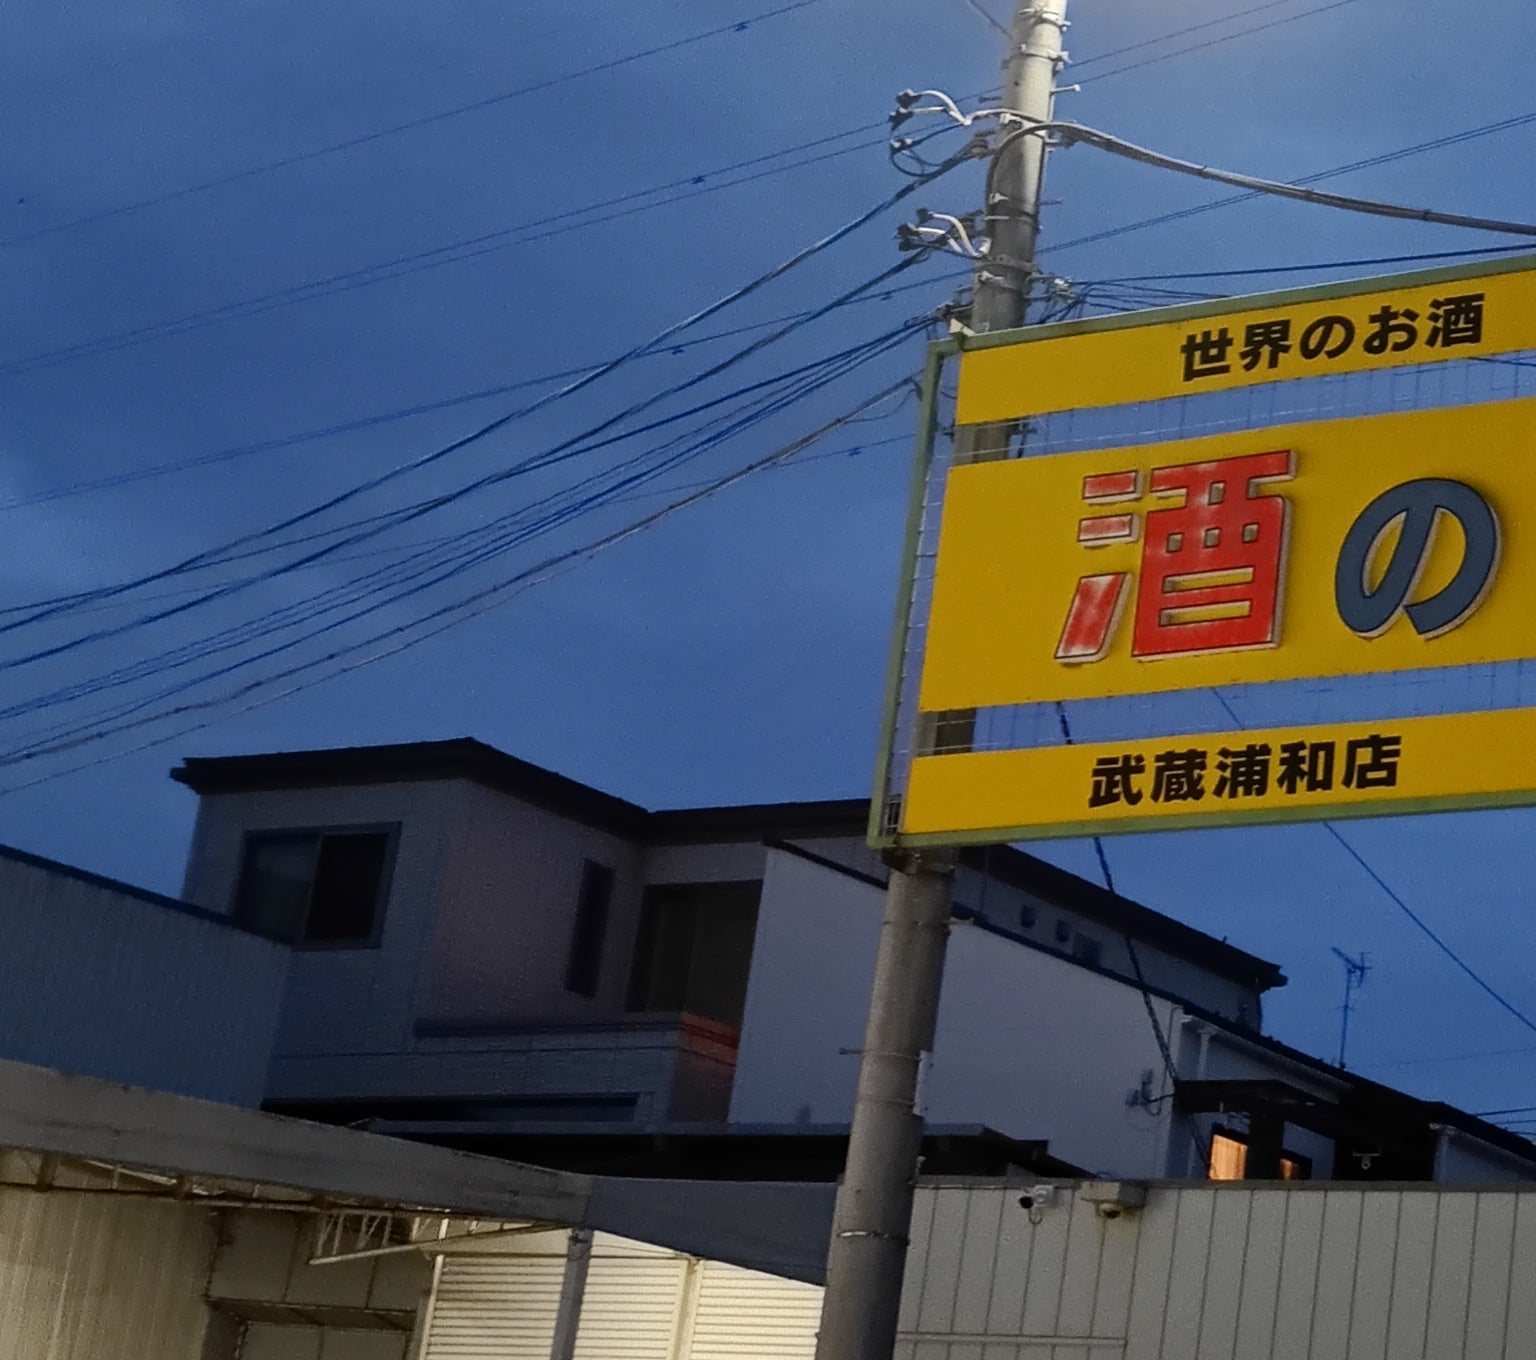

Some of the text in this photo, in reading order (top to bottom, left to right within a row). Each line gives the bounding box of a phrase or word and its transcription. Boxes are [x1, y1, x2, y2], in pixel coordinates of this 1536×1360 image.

[1180, 293, 1485, 382] 世界のお酒
[1088, 734, 1402, 809] 武蔵浦和店
